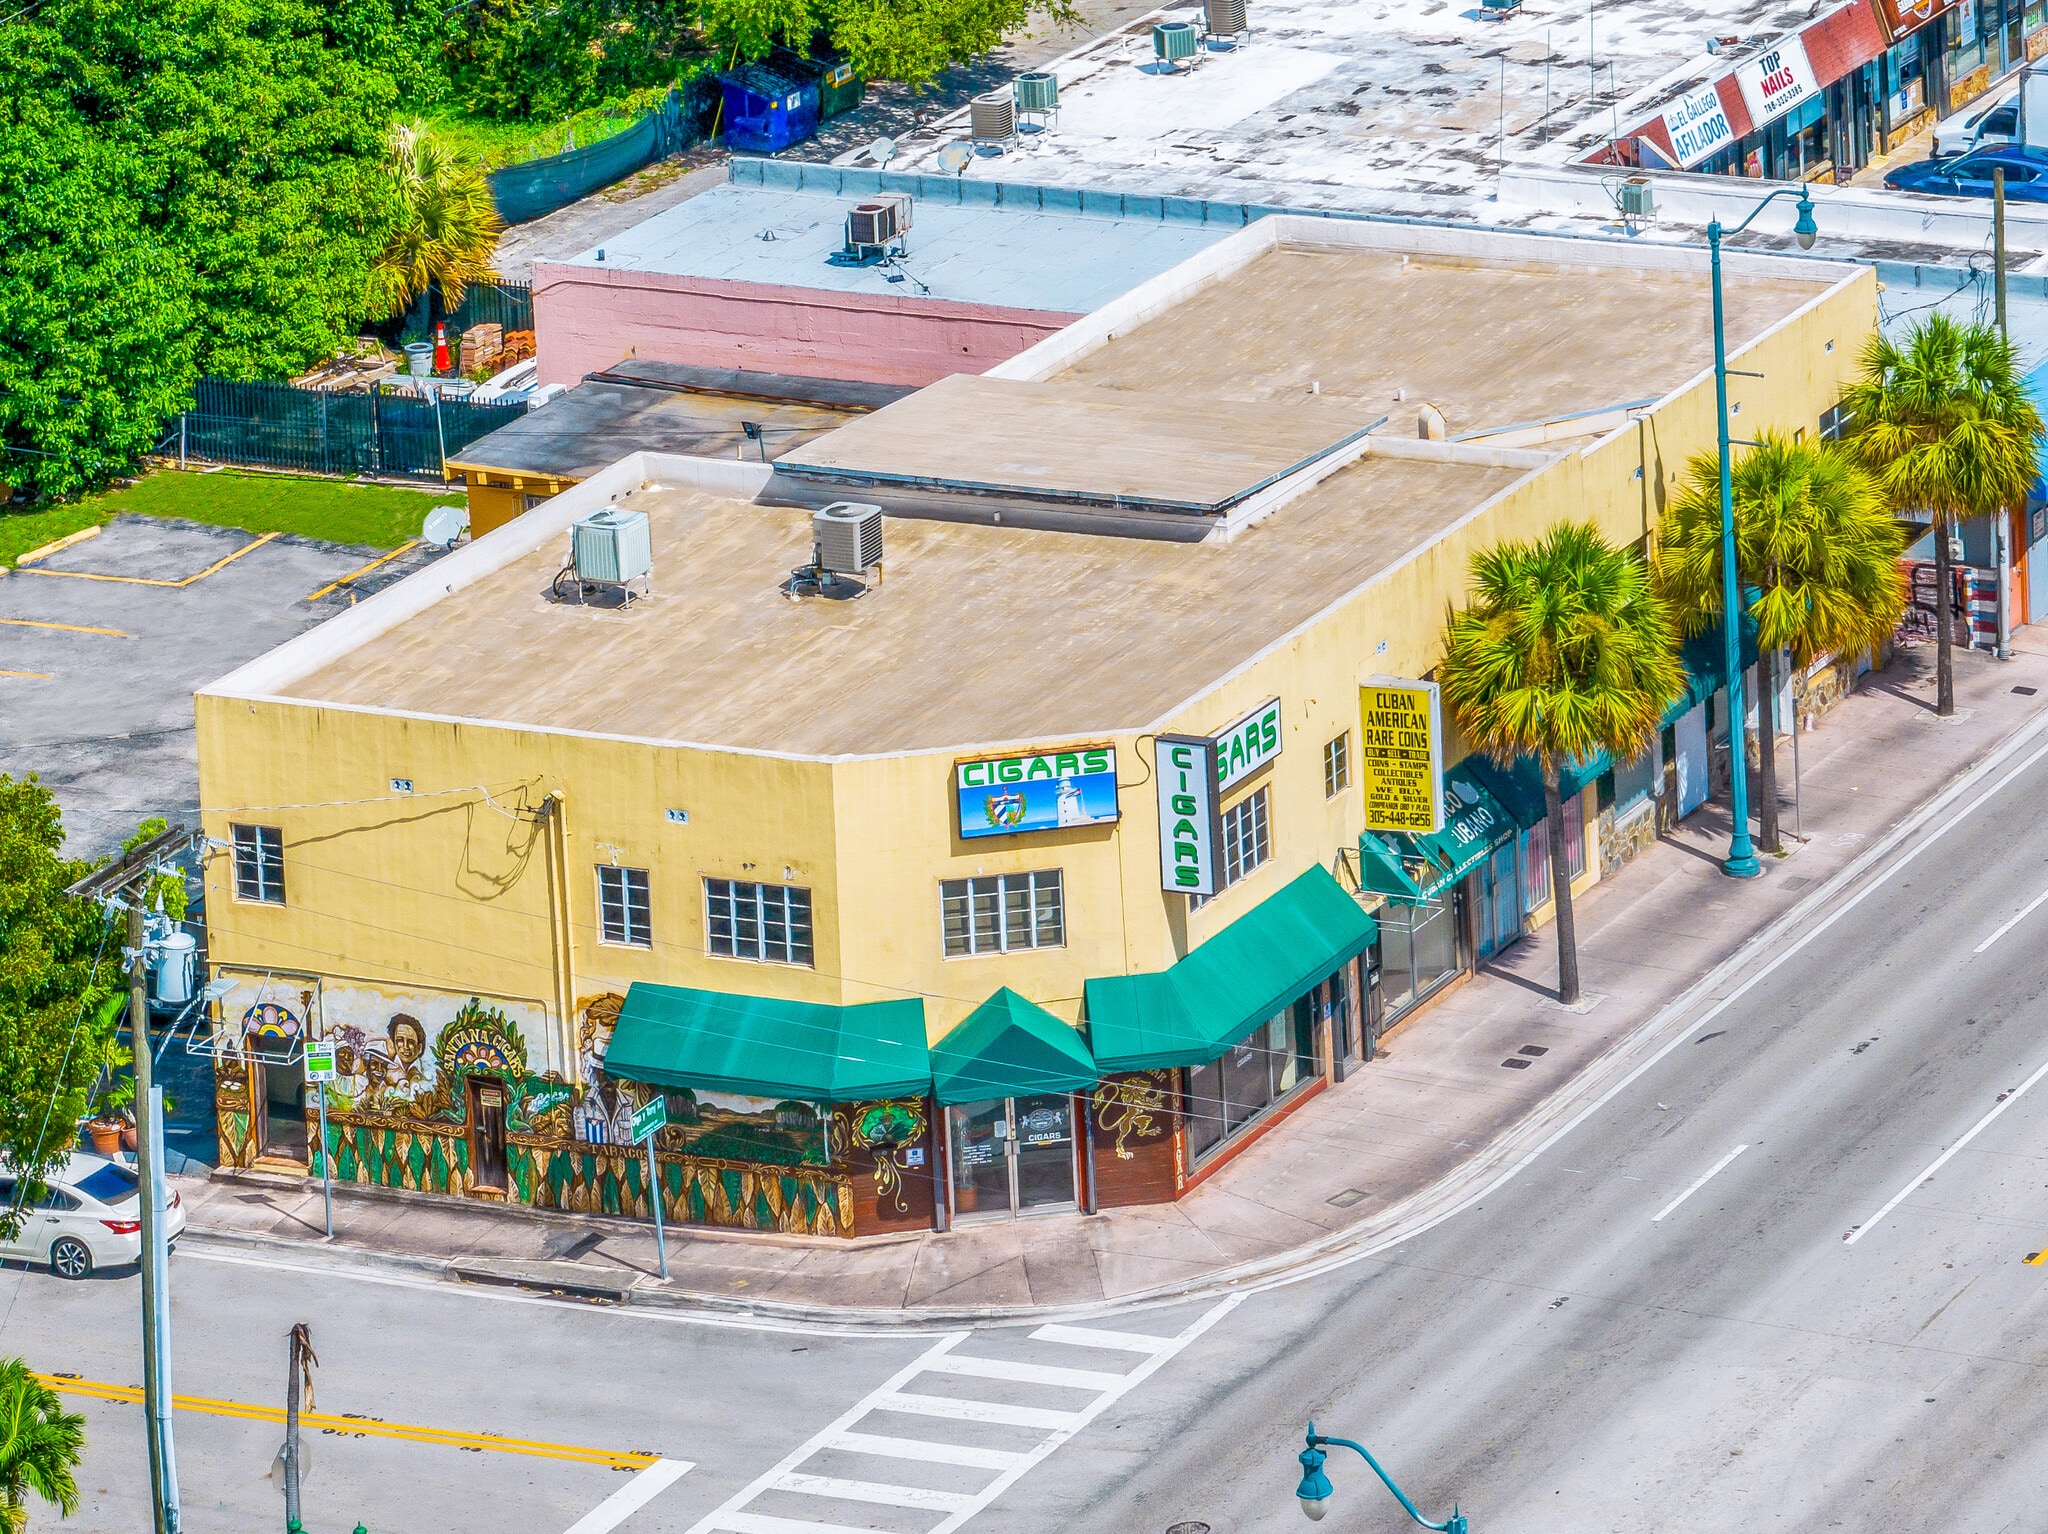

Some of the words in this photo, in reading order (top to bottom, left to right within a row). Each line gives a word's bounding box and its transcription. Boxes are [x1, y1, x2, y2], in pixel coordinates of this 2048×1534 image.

[1758, 50, 1781, 76] TOP
[1760, 66, 1794, 98] NAILS
[1676, 110, 1689, 127] EL
[1687, 92, 1717, 121] GALLEGO
[1674, 113, 1729, 161] AFILADOR
[1376, 692, 1415, 711] CUBAN
[1366, 710, 1427, 731] AMERICAN
[1366, 729, 1394, 747] RARE
[1398, 731, 1428, 749] COINS
[1367, 748, 1380, 757] BUY
[1387, 749, 1401, 758] SELL
[1408, 751, 1428, 760] TRADE
[963, 749, 1110, 787] CIGARS
[1367, 759, 1390, 768] COINS
[1399, 761, 1429, 771] STAMPS
[1373, 769, 1424, 780] COLLECTIBLES
[1375, 786, 1394, 794] WE
[1399, 788, 1423, 796] BUY
[1381, 778, 1418, 787] ANTIQUES
[1370, 793, 1391, 801] GOLD
[1402, 795, 1429, 804] SILVER
[1171, 746, 1200, 888] CIGARS
[1368, 809, 1432, 827] 305-448-6256
[1450, 806, 1496, 849] UBANO
[443, 1028, 490, 1075] SANTANA
[492, 1034, 526, 1079] CIGARS
[1028, 1131, 1062, 1142] CIGARS
